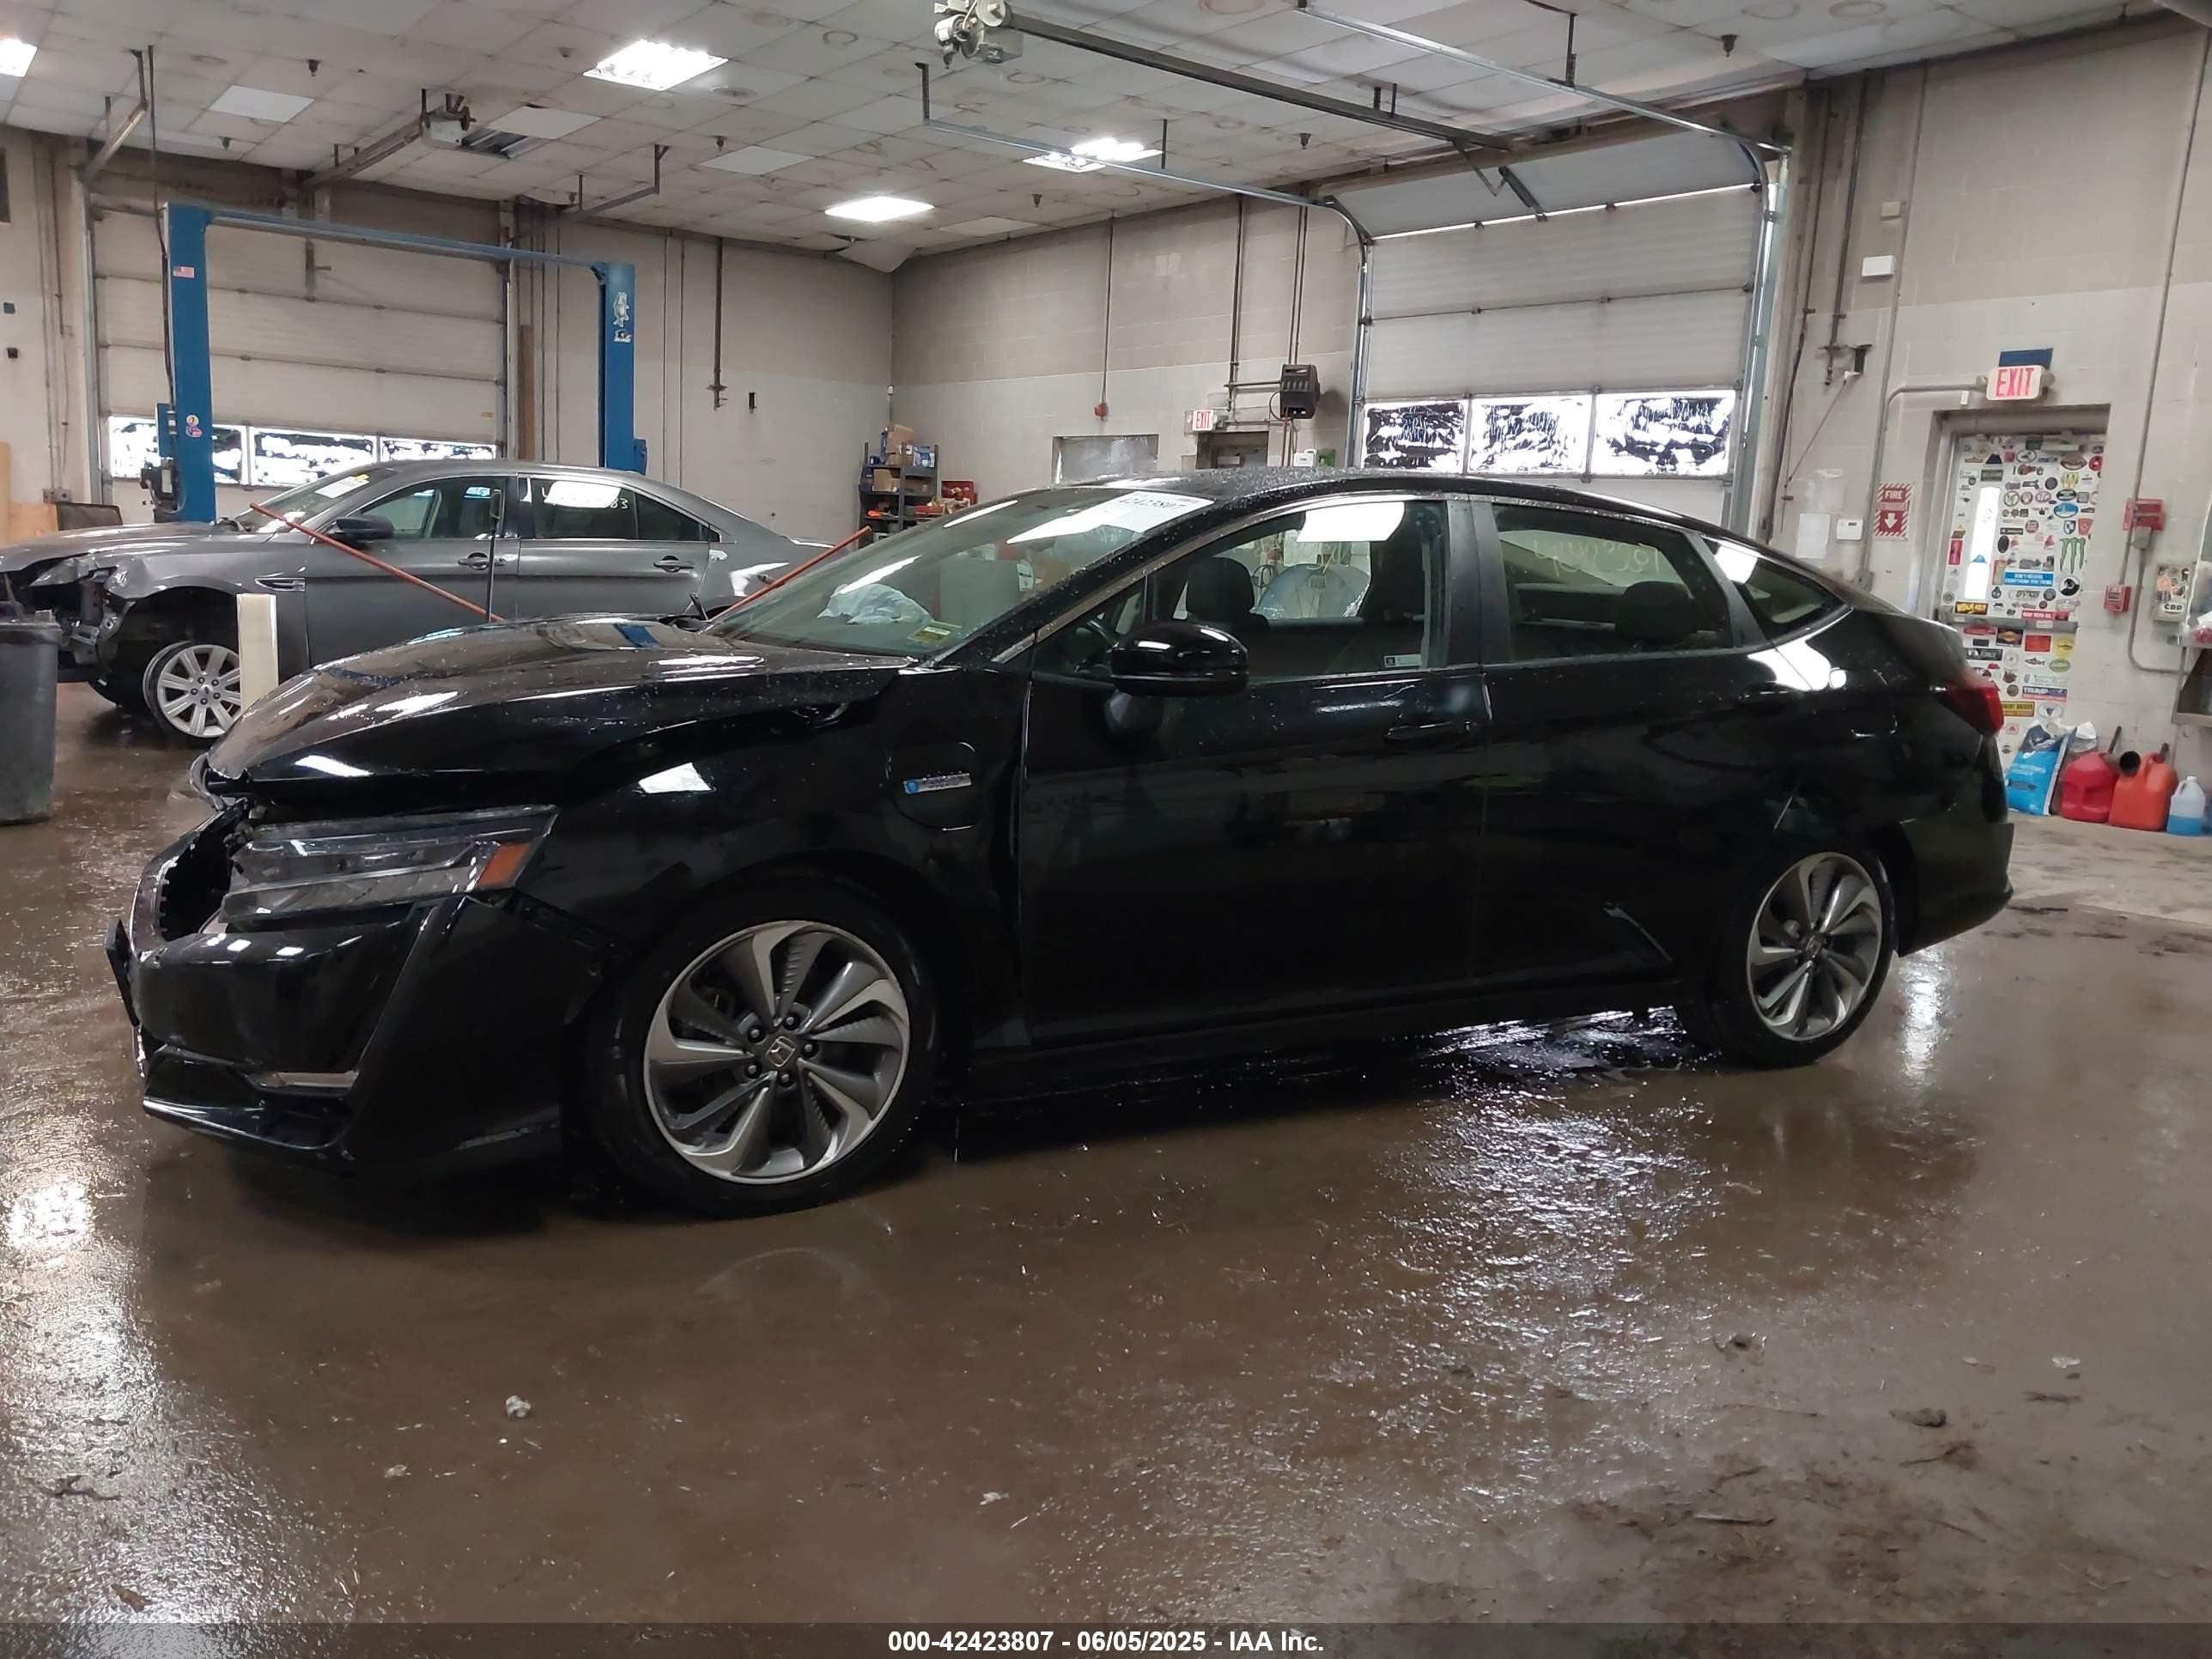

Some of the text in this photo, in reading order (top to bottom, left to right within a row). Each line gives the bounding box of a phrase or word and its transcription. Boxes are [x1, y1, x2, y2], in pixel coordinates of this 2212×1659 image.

[1996, 368, 2034, 397] EXIT
[1196, 411, 1210, 428] EXIT
[1886, 490, 1904, 499] FIRE
